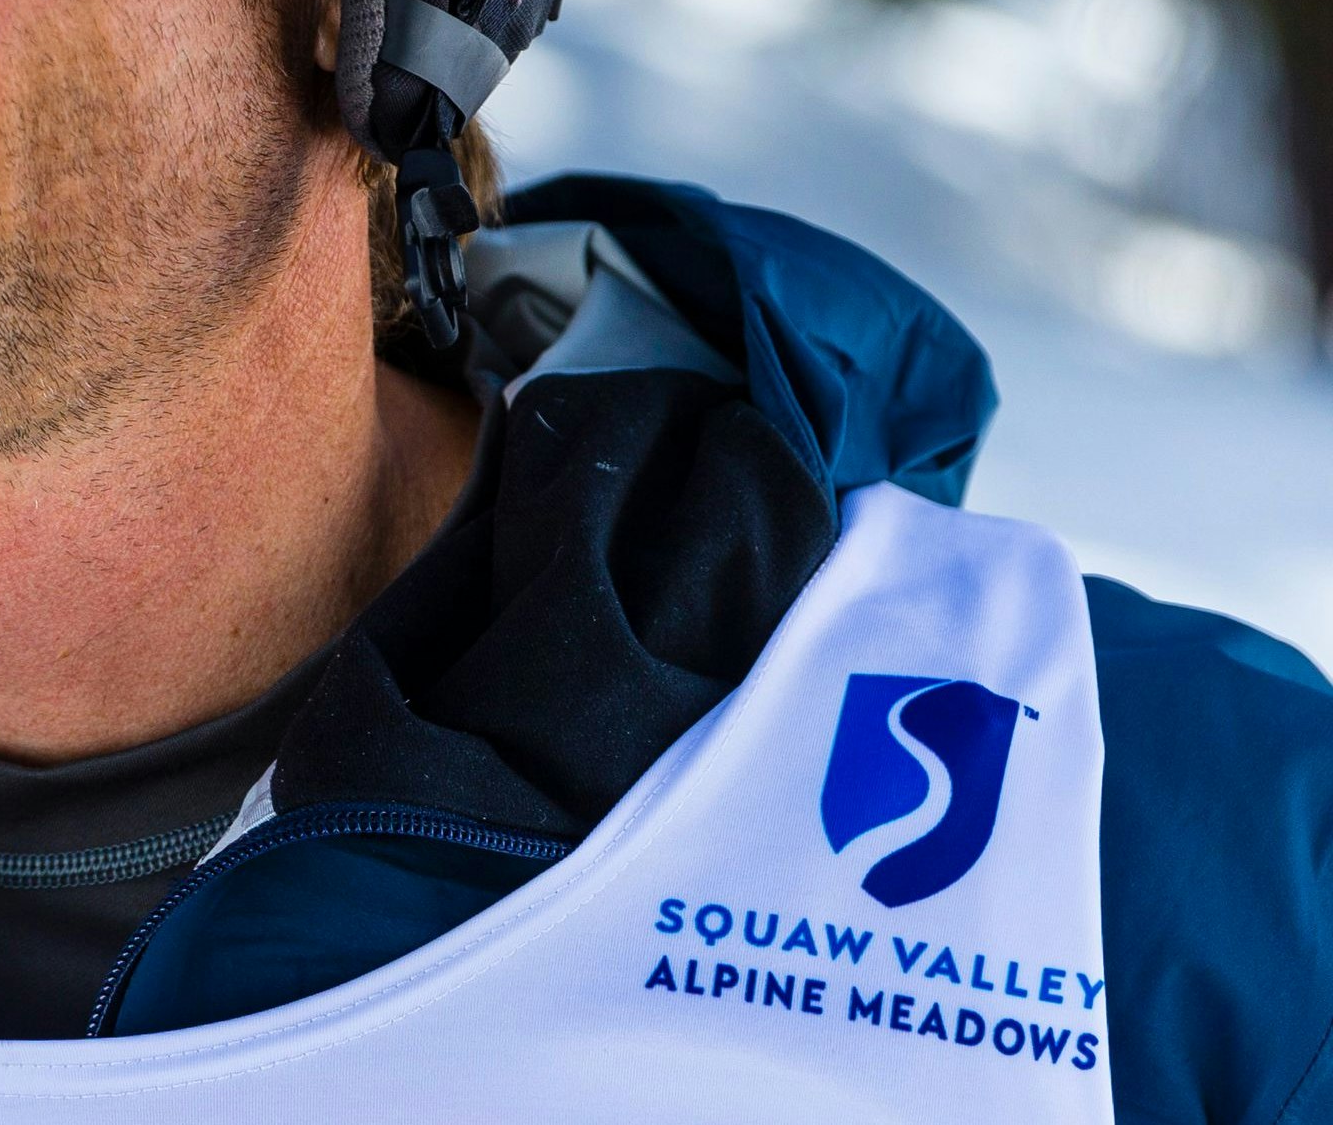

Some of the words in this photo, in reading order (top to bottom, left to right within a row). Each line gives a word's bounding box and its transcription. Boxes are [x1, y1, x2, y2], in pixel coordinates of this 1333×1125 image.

[654, 898, 874, 965] SQUAW
[892, 936, 1105, 1009] VALLEY
[645, 955, 826, 1015] ALPINE
[848, 986, 1100, 1071] MEADOWS
